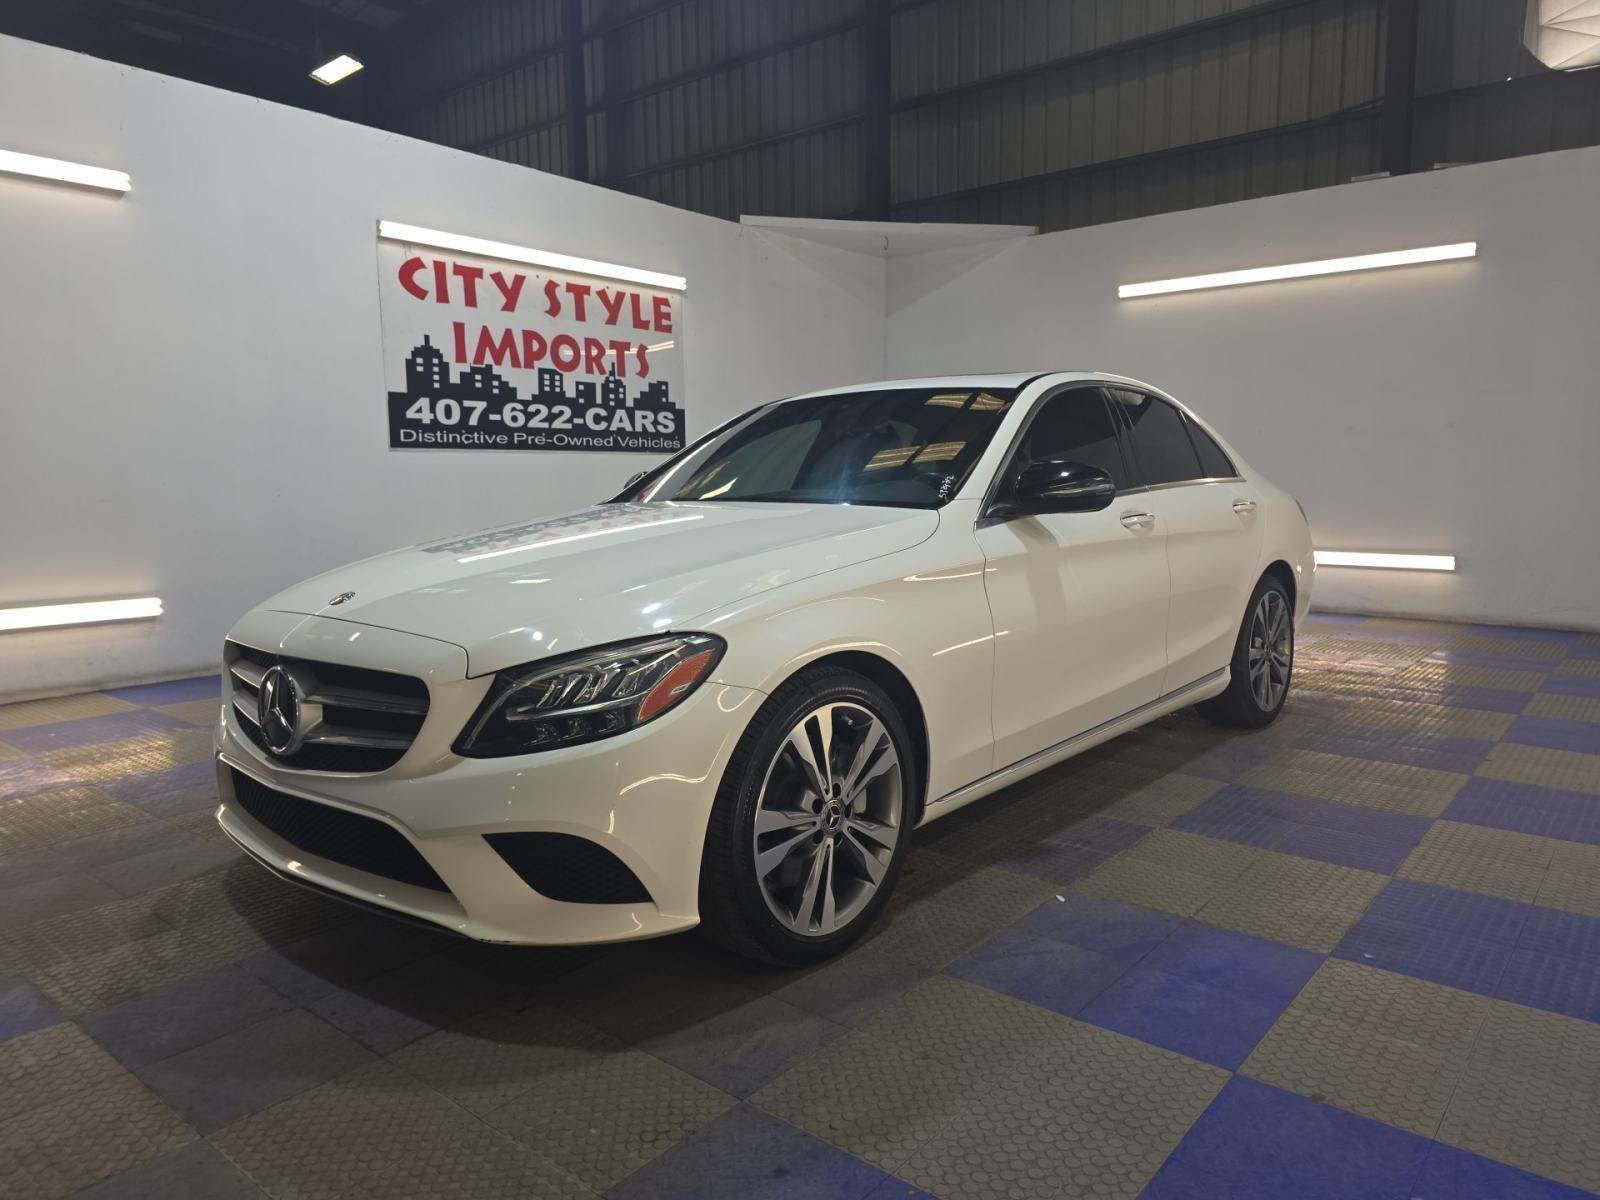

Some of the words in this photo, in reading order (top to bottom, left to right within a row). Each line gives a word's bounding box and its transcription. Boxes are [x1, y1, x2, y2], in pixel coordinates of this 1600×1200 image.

[398, 257, 526, 312] CITY
[544, 279, 673, 333] STYLE
[452, 321, 650, 378] IMPORTS
[405, 397, 676, 433] 407-622-CARS
[400, 428, 508, 444] Distinctive
[513, 432, 613, 447] Pre-Owned
[617, 436, 680, 449] Vehicles
